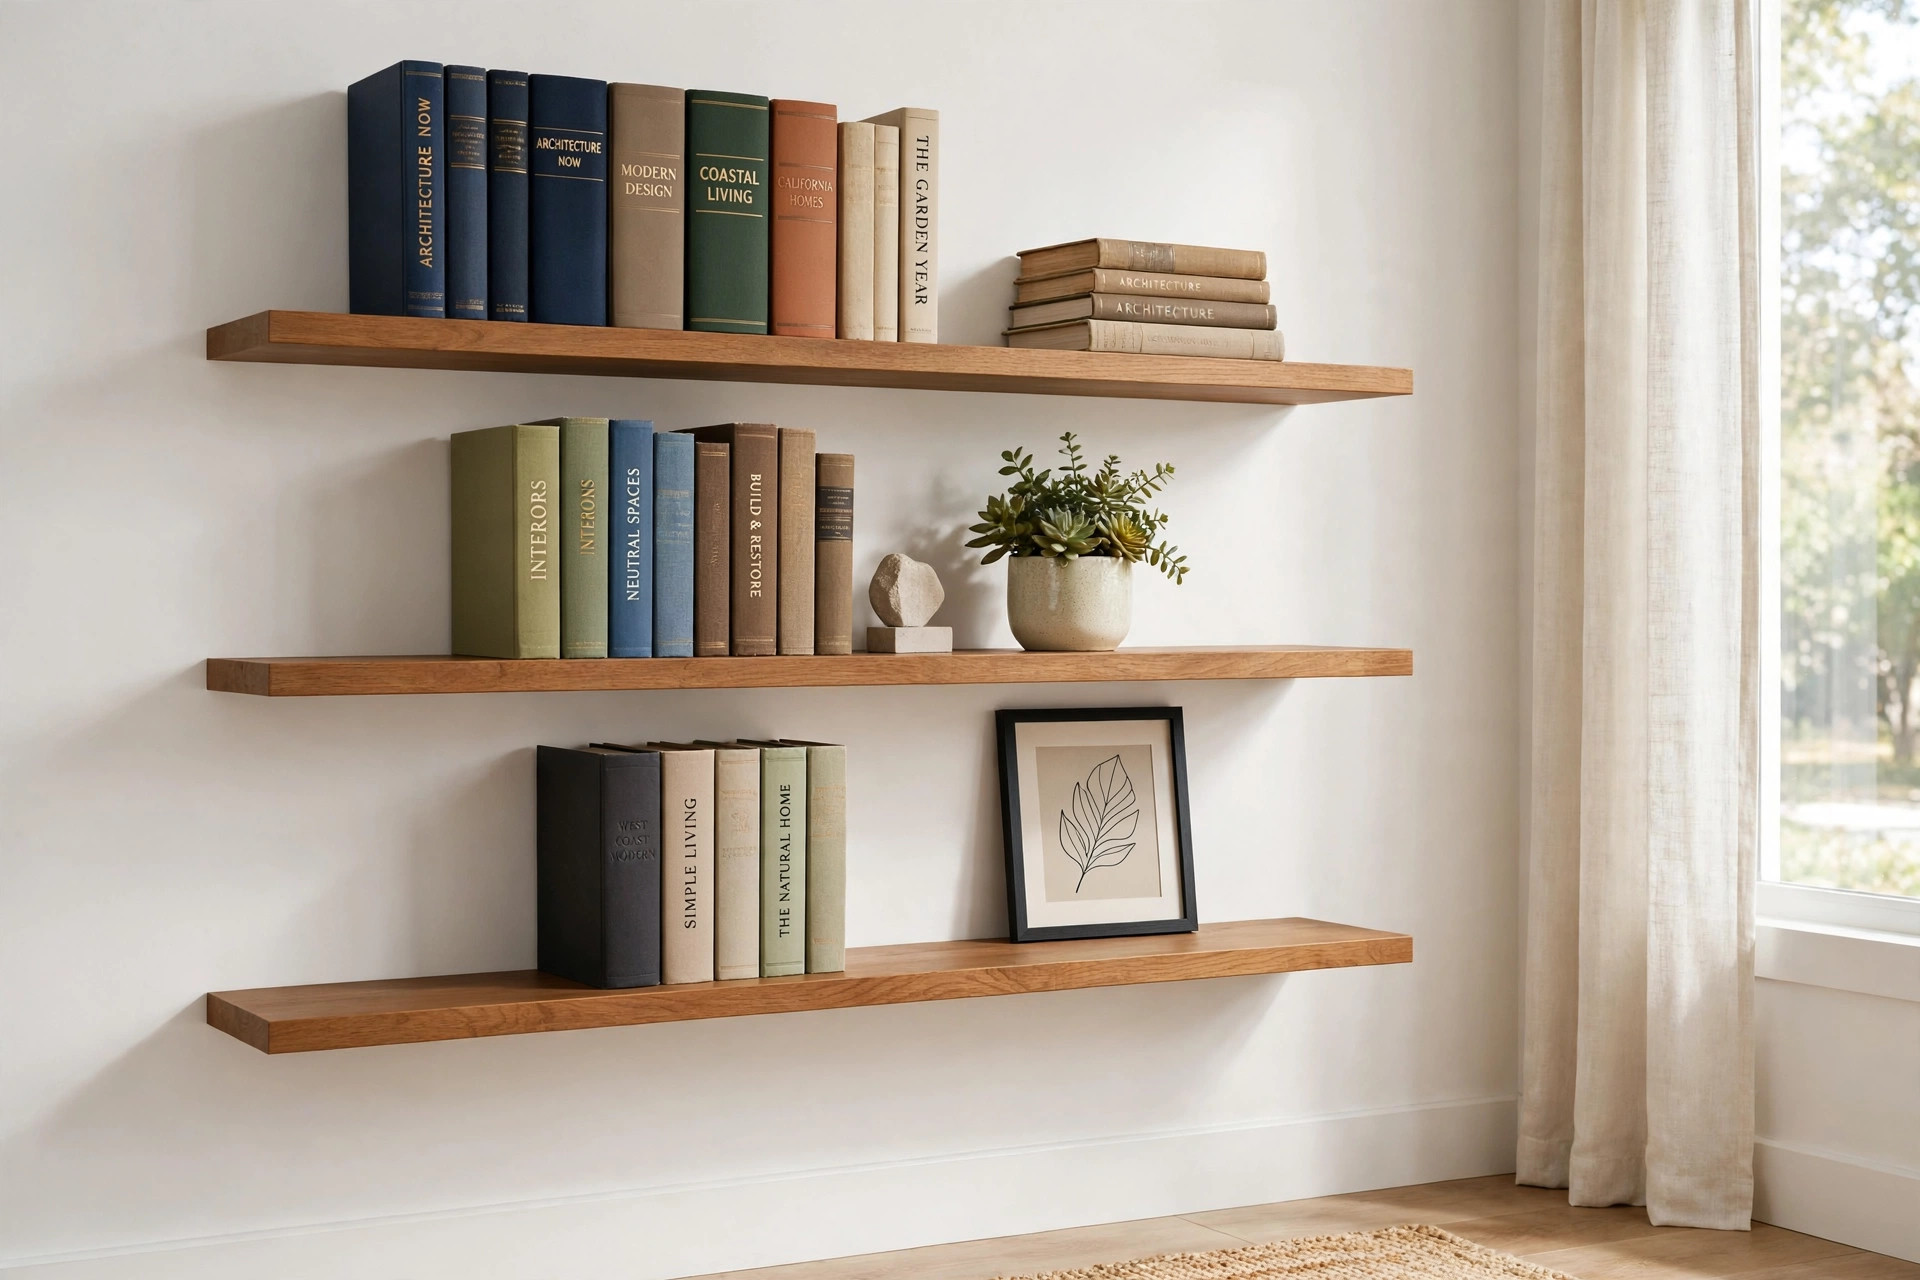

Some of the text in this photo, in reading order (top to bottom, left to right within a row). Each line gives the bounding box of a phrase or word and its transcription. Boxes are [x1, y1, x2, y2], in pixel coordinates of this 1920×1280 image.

[536, 137, 602, 154] ARCHITECTURE
[558, 156, 581, 168] NOW
[621, 164, 677, 181] MODERN
[699, 166, 760, 186] COASTAL
[418, 97, 433, 268] ARCHITECTURE NOW
[625, 182, 673, 198] DESIGN
[777, 175, 833, 192] CALIFORNIA
[707, 186, 753, 204] LIVING
[789, 194, 824, 209] HOMES
[915, 135, 929, 306] THE GARDEN YEAR
[1119, 276, 1201, 292] ARCHITECTURE
[1116, 302, 1215, 320] ARCHITECTURE
[530, 480, 547, 581] INTERORS
[627, 468, 640, 601] NEUTRAL SPACES
[750, 474, 762, 598] BUILD & RESTORE
[617, 820, 649, 832] WEST
[615, 834, 651, 847] COAST
[684, 798, 697, 929] SIMPLE LIVING
[779, 784, 791, 938] THE NATURAL HOME
